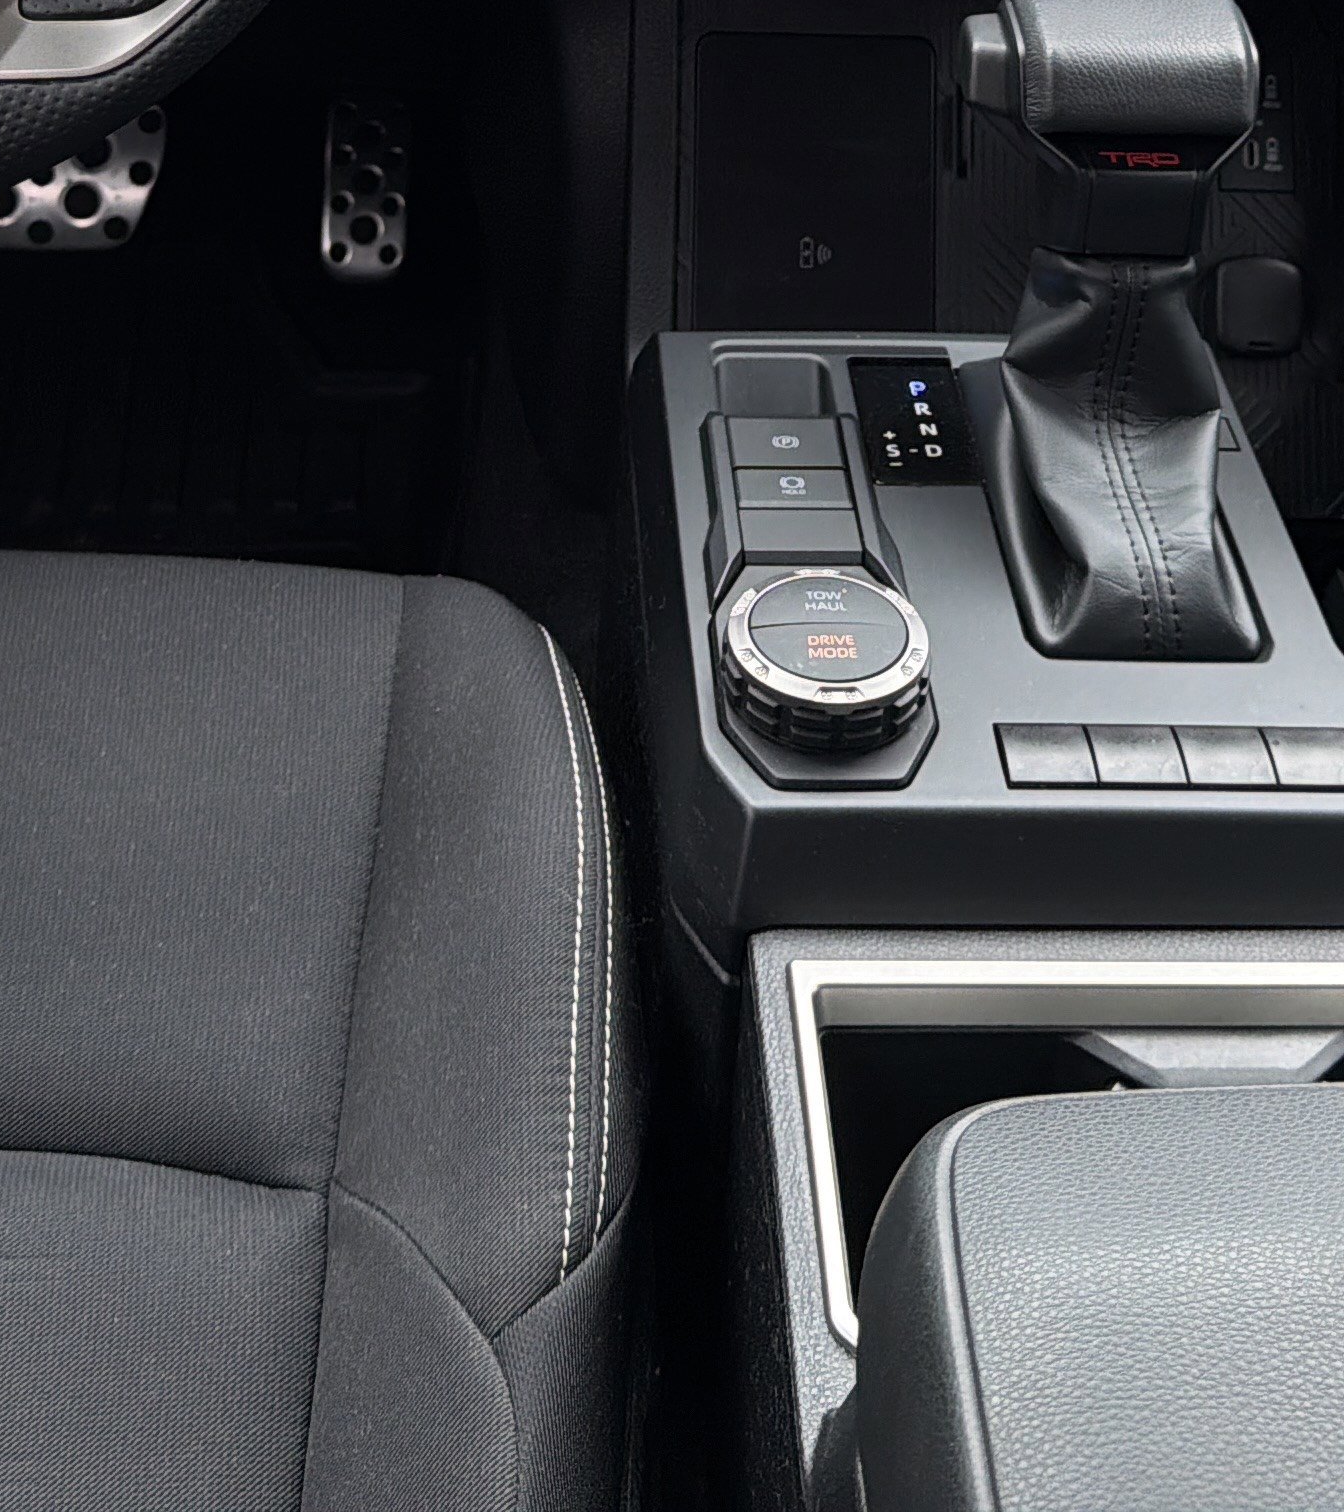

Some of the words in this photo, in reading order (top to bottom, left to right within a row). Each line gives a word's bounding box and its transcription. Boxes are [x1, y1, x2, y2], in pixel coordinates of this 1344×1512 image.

[1098, 151, 1182, 168] TRD
[908, 380, 927, 397] P
[913, 402, 933, 416] R
[919, 423, 939, 436] N
[886, 443, 901, 458] S
[924, 444, 943, 457] D
[805, 590, 842, 600] TOW
[804, 601, 848, 612] HAUL
[807, 635, 856, 646] DRIVE
[807, 647, 858, 659] MODE
